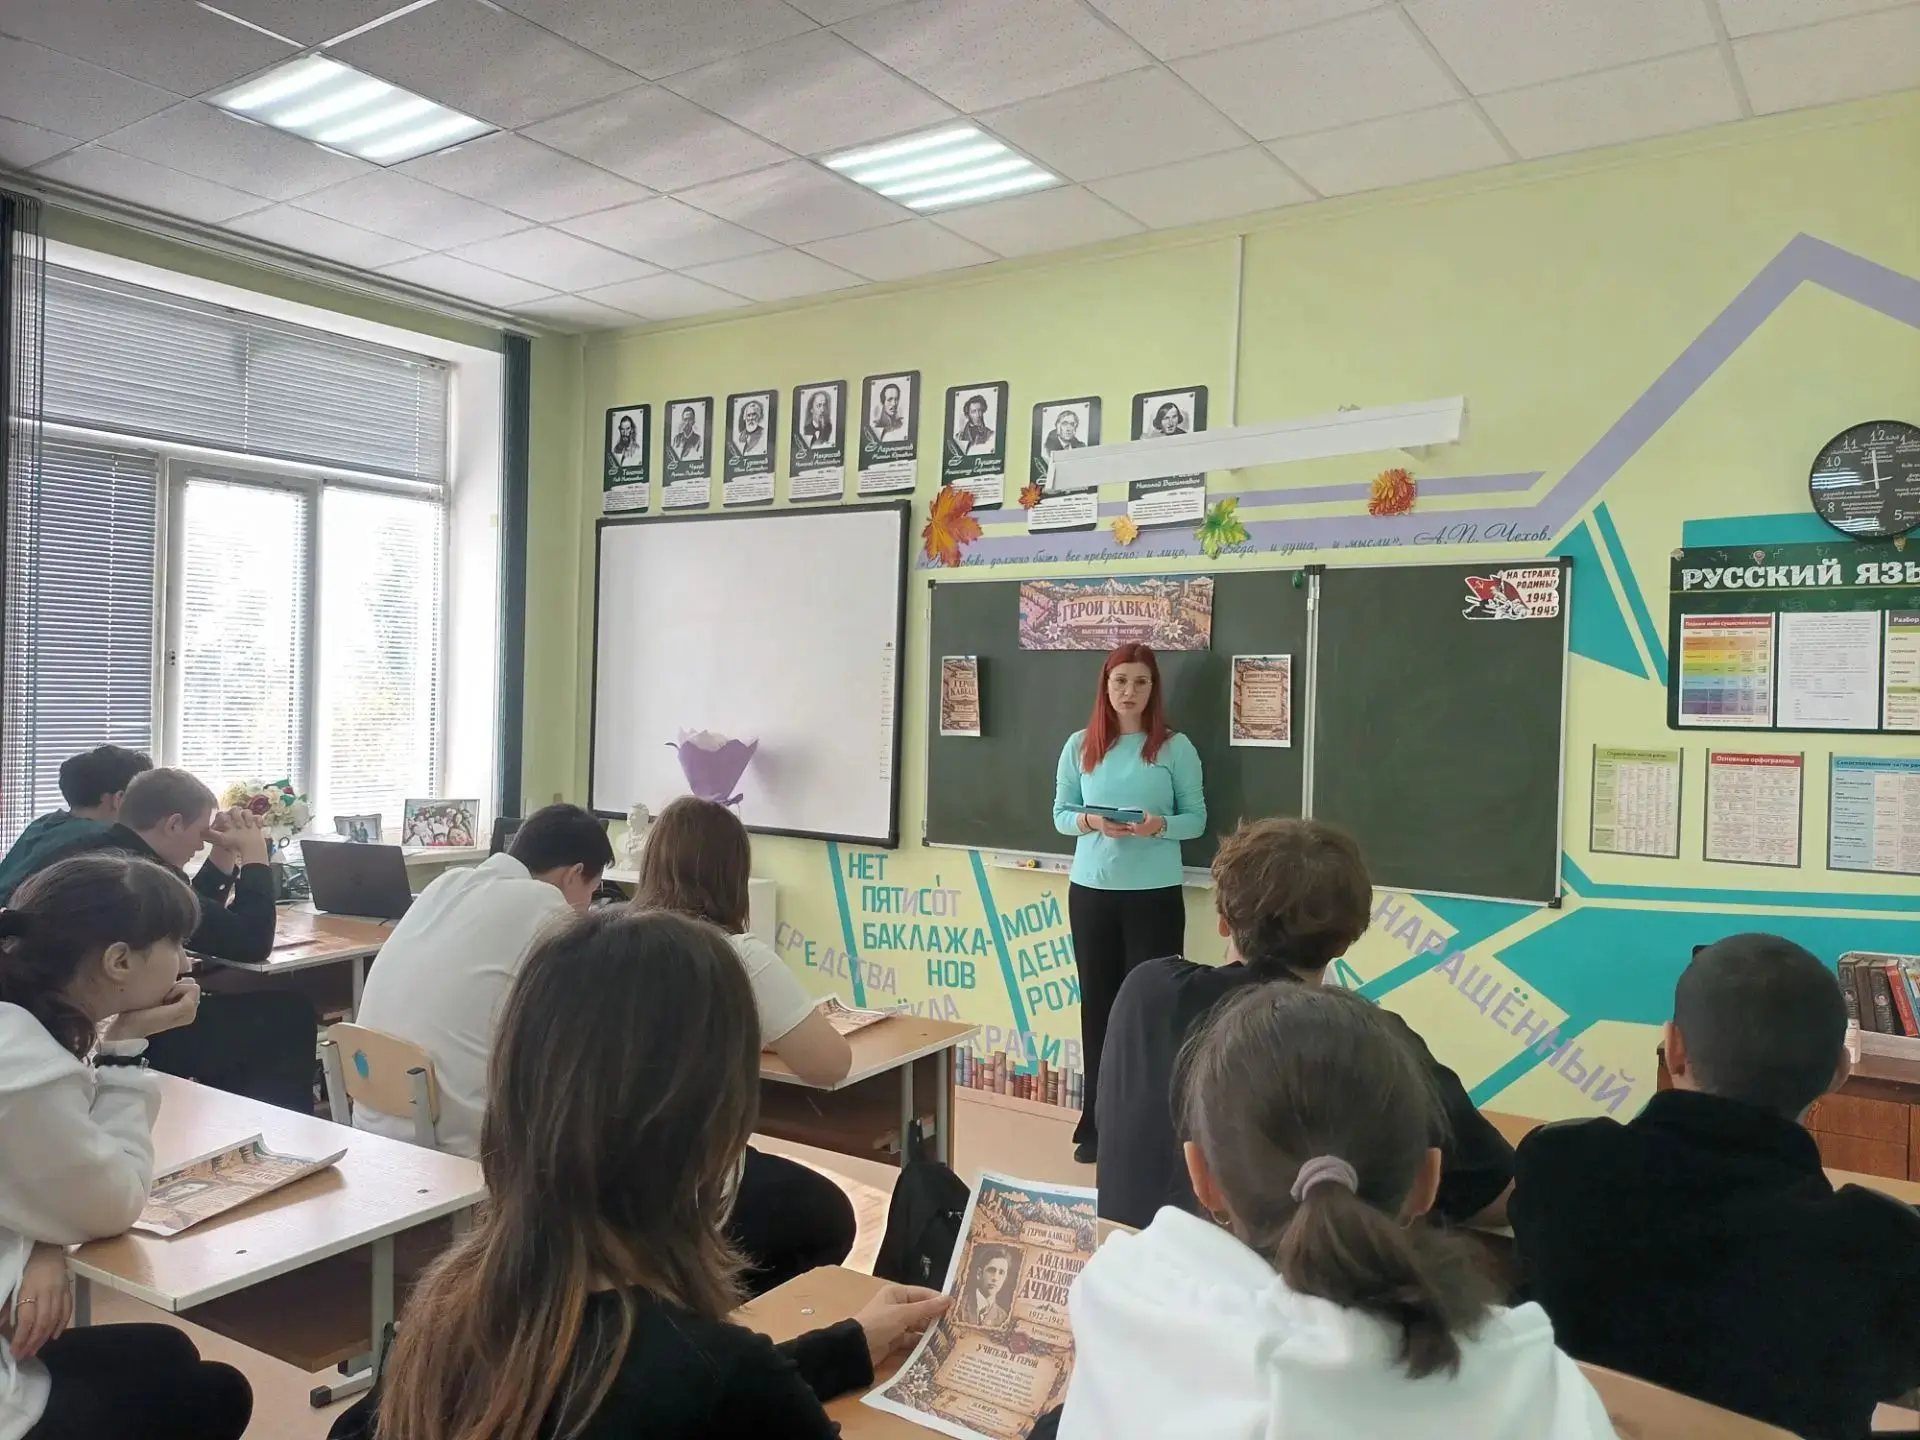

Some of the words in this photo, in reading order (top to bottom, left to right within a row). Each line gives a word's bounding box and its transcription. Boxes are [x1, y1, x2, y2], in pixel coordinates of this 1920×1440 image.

[1843, 439, 1858, 450] 11
[1871, 430, 1885, 441] 12
[1826, 456, 1841, 468] 10
[1828, 501, 1835, 513] 8
[1894, 509, 1902, 521] 5
[1033, 548, 1058, 563] быть
[1146, 549, 1153, 558] и
[1270, 542, 1277, 552] и
[1506, 571, 1518, 580] НА
[1522, 569, 1557, 579] СТРАЖЕ
[1681, 558, 1843, 591] РУССКИЙ
[1516, 580, 1557, 589] РОДИНЫ!
[1063, 600, 1104, 621] ГЕРОИ
[1530, 605, 1558, 616] 1945
[1893, 616, 1920, 624] Разбор
[848, 853, 888, 880] НЕТ
[1000, 890, 1063, 941] МОЙ
[862, 922, 992, 956] БАКЛАЖА-
[775, 920, 897, 996] СРЕДСТВА
[927, 959, 976, 989] НОВ
[1036, 1252, 1085, 1274] АЙДАМИР
[1026, 1265, 1078, 1288] АХМЕДОВ
[975, 1343, 1009, 1360] УЧИТЕЛЬ
